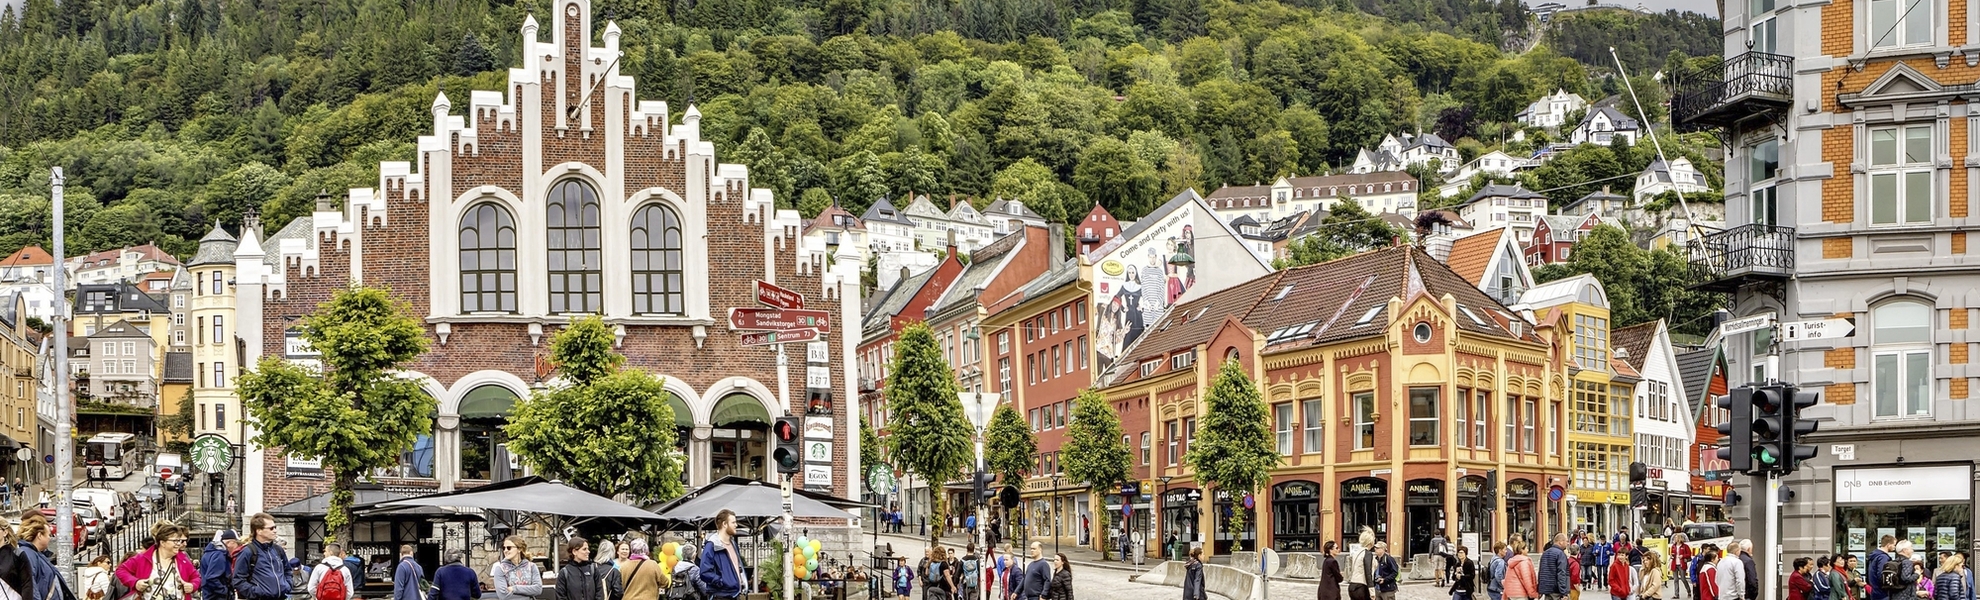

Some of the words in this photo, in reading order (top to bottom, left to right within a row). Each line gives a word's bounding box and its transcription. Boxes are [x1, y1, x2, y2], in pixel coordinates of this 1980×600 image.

[1120, 243, 1139, 259] Come
[1139, 235, 1151, 247] and
[1150, 224, 1167, 241] party
[1167, 214, 1180, 228] with
[1180, 208, 1191, 219] us!
[756, 320, 796, 328] Sandvikstorget
[777, 331, 800, 339] Sentrum
[1031, 481, 1050, 489] RUBENS
[1350, 484, 1370, 492] ANNE
[1463, 482, 1476, 490] ANNE
[1218, 490, 1229, 498] LOS
[1284, 486, 1302, 494] ANNE
[1166, 494, 1176, 502] LOS
